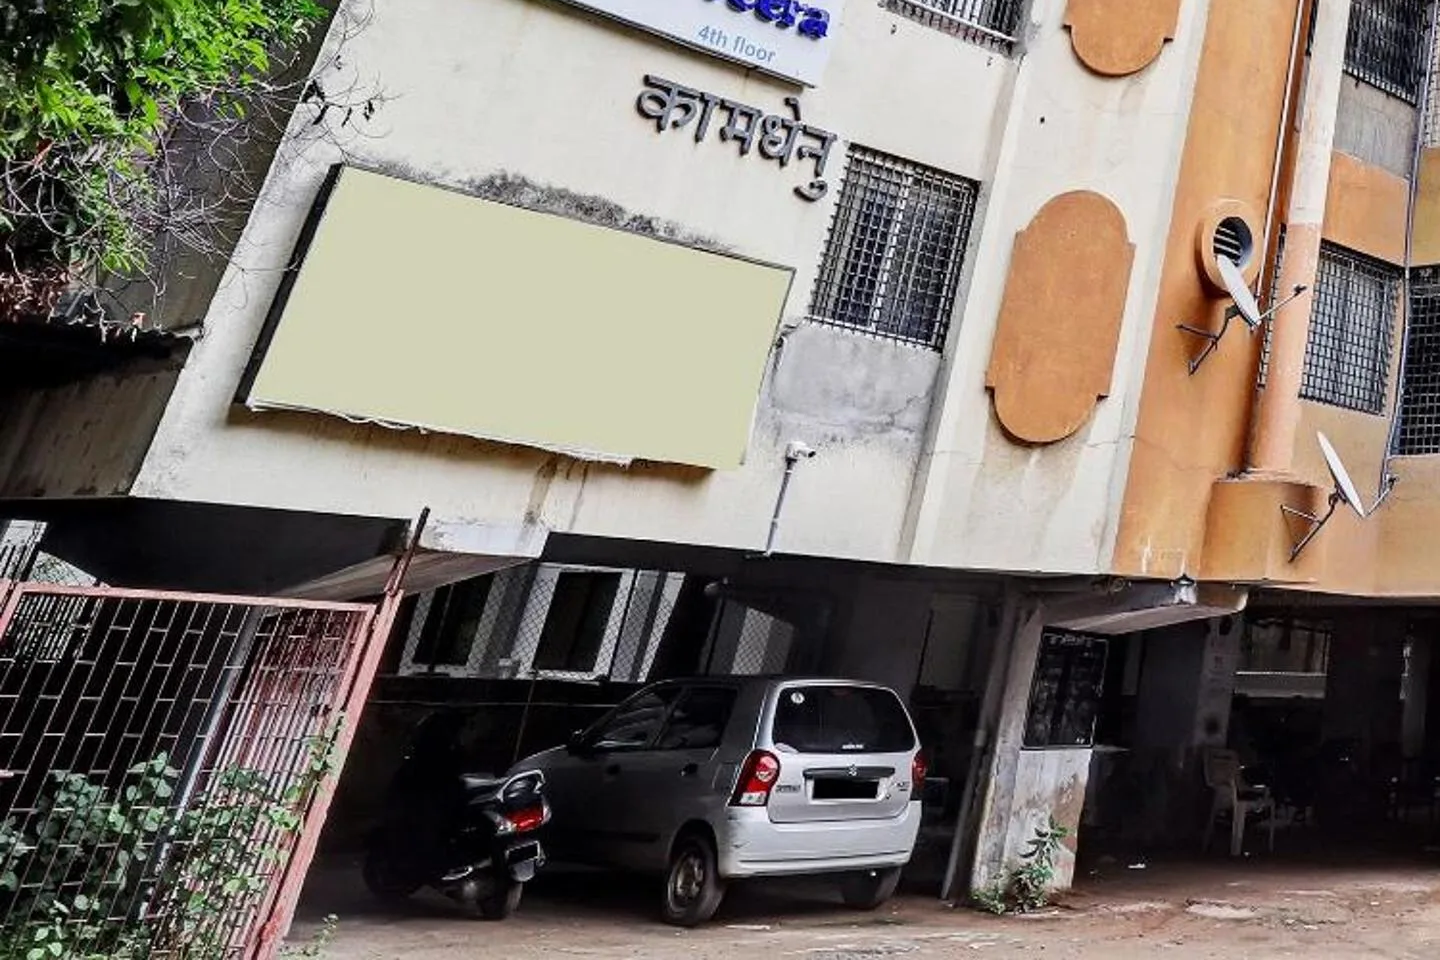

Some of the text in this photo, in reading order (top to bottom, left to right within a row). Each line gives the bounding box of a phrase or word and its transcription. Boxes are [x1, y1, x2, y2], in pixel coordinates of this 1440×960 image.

[698, 24, 776, 64] 4th floor
[636, 74, 838, 200] कामधेनु
